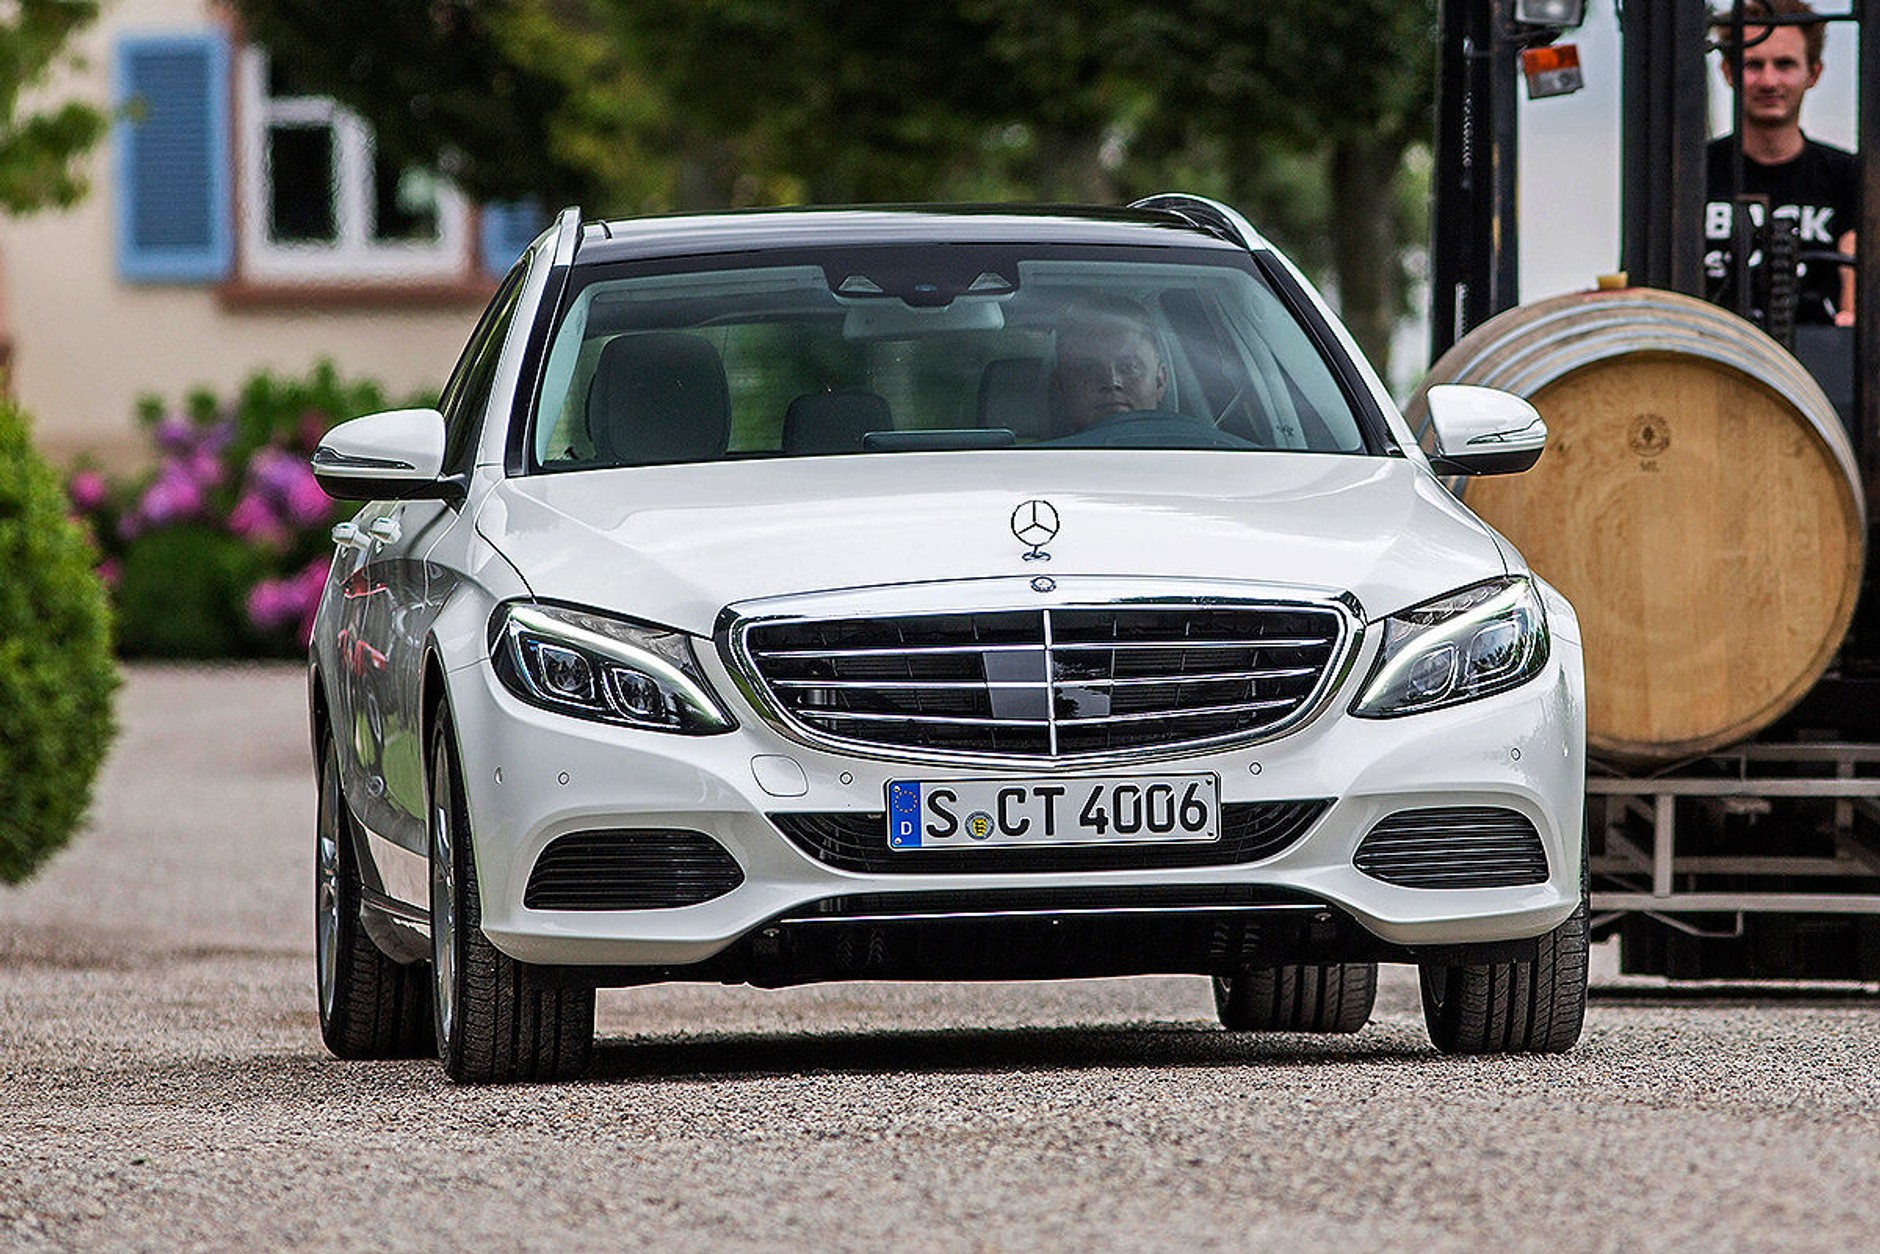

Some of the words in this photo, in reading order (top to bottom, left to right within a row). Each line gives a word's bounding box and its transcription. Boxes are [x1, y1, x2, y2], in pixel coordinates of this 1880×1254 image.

[925, 790, 959, 838] S
[997, 787, 1066, 837] CT
[1079, 783, 1209, 835] 4006
[900, 821, 913, 836] D
